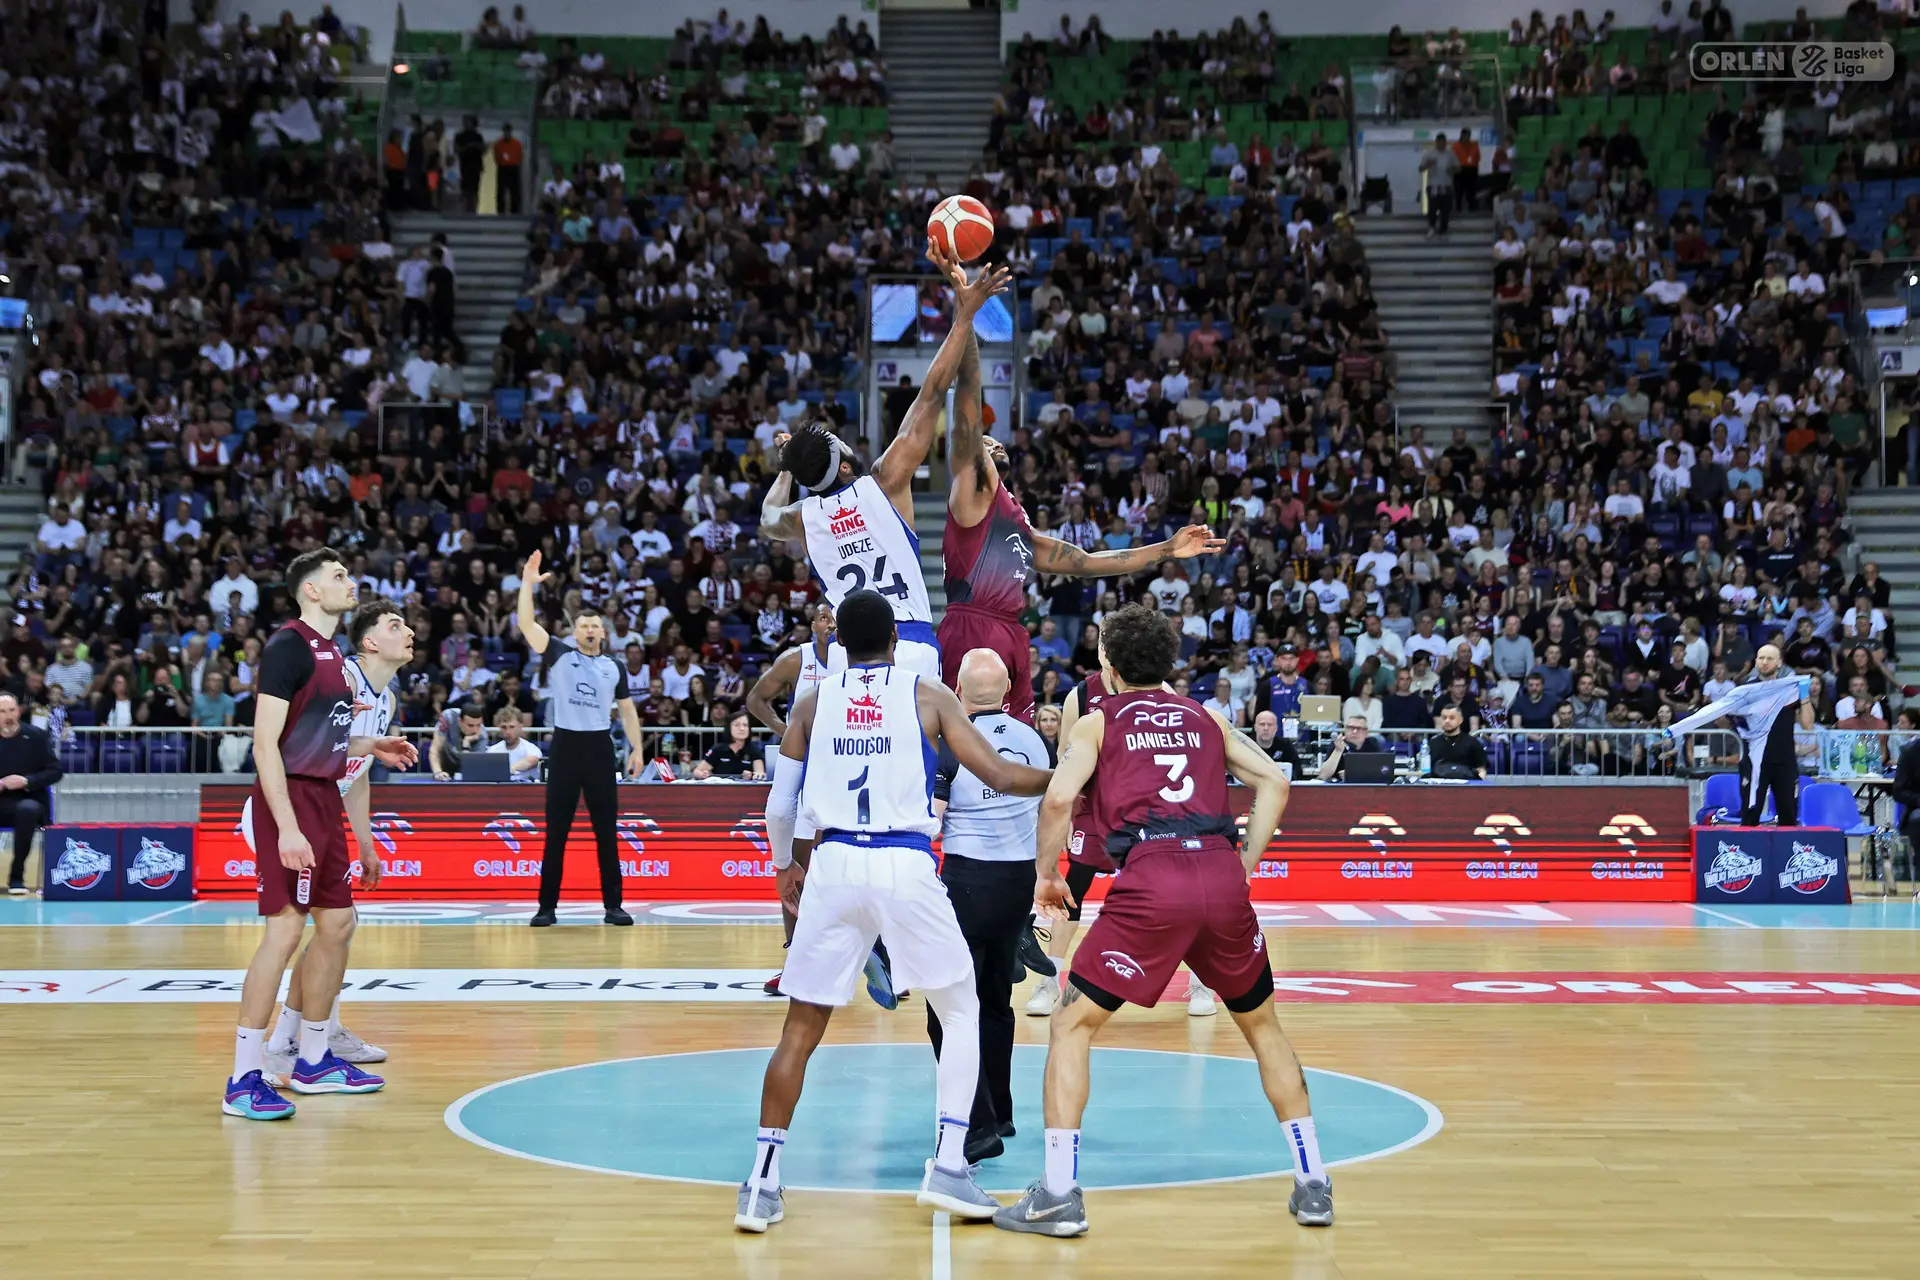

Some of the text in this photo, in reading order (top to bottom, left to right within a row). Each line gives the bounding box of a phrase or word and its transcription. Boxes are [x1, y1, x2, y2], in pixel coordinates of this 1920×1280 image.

[830, 514, 865, 535] KING
[834, 526, 868, 540] HURTOWNIE
[838, 537, 875, 560] UDEZE
[836, 555, 909, 600] 24
[847, 705, 883, 725] KING
[1134, 711, 1184, 727] PGE
[993, 725, 1007, 734] 4F
[1125, 731, 1201, 751] DANIELS IV
[1153, 754, 1195, 802] 3
[848, 765, 871, 824] 1
[350, 860, 421, 877] OLEN
[474, 860, 542, 876] ORLEN
[618, 860, 670, 877] RLEN
[721, 860, 777, 877] ORLE
[1341, 862, 1413, 879] ORLEN
[1466, 862, 1538, 879] ORLEN
[1591, 862, 1664, 879] ORLEN
[1105, 958, 1136, 979] PGE
[1451, 980, 1920, 995] ORLEN
